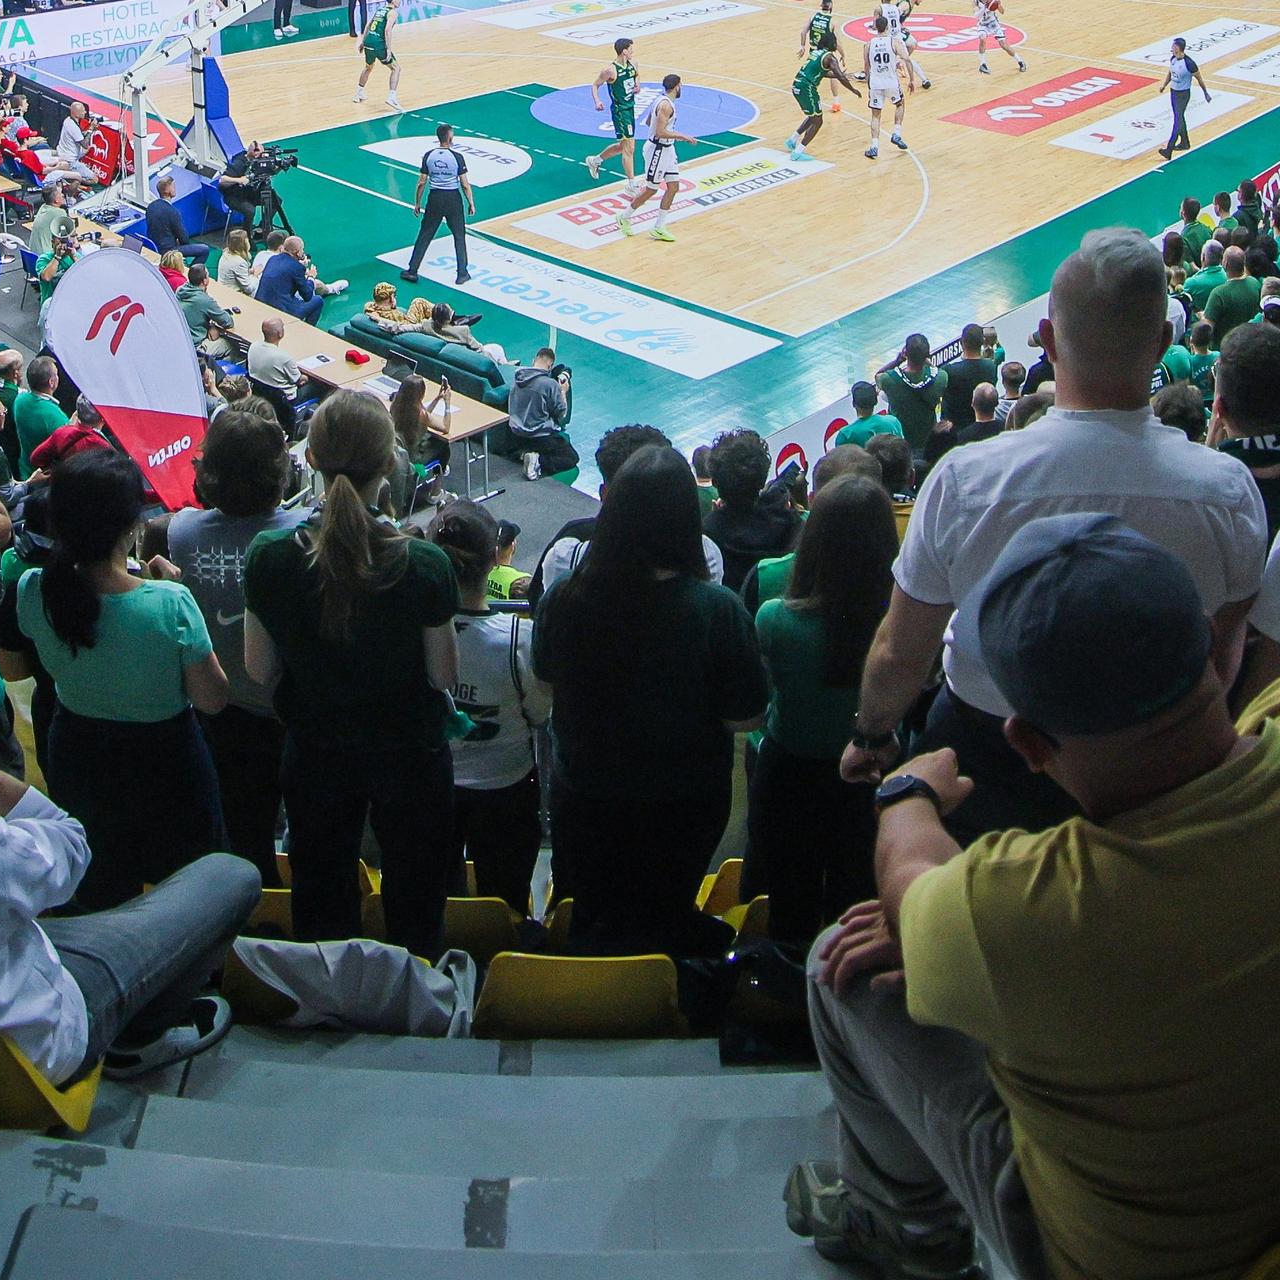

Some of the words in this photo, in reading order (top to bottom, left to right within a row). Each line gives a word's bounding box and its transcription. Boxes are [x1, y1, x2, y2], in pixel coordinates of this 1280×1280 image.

[103, 0, 159, 22] HOTEL
[617, 15, 671, 31] Bank
[672, 3, 740, 20] Pekao
[873, 52, 890, 64] 40
[1032, 76, 1121, 108] ORLEN
[648, 149, 662, 177] LEGIA
[702, 161, 770, 188] MARCHE
[703, 169, 800, 206] POMORSKIE
